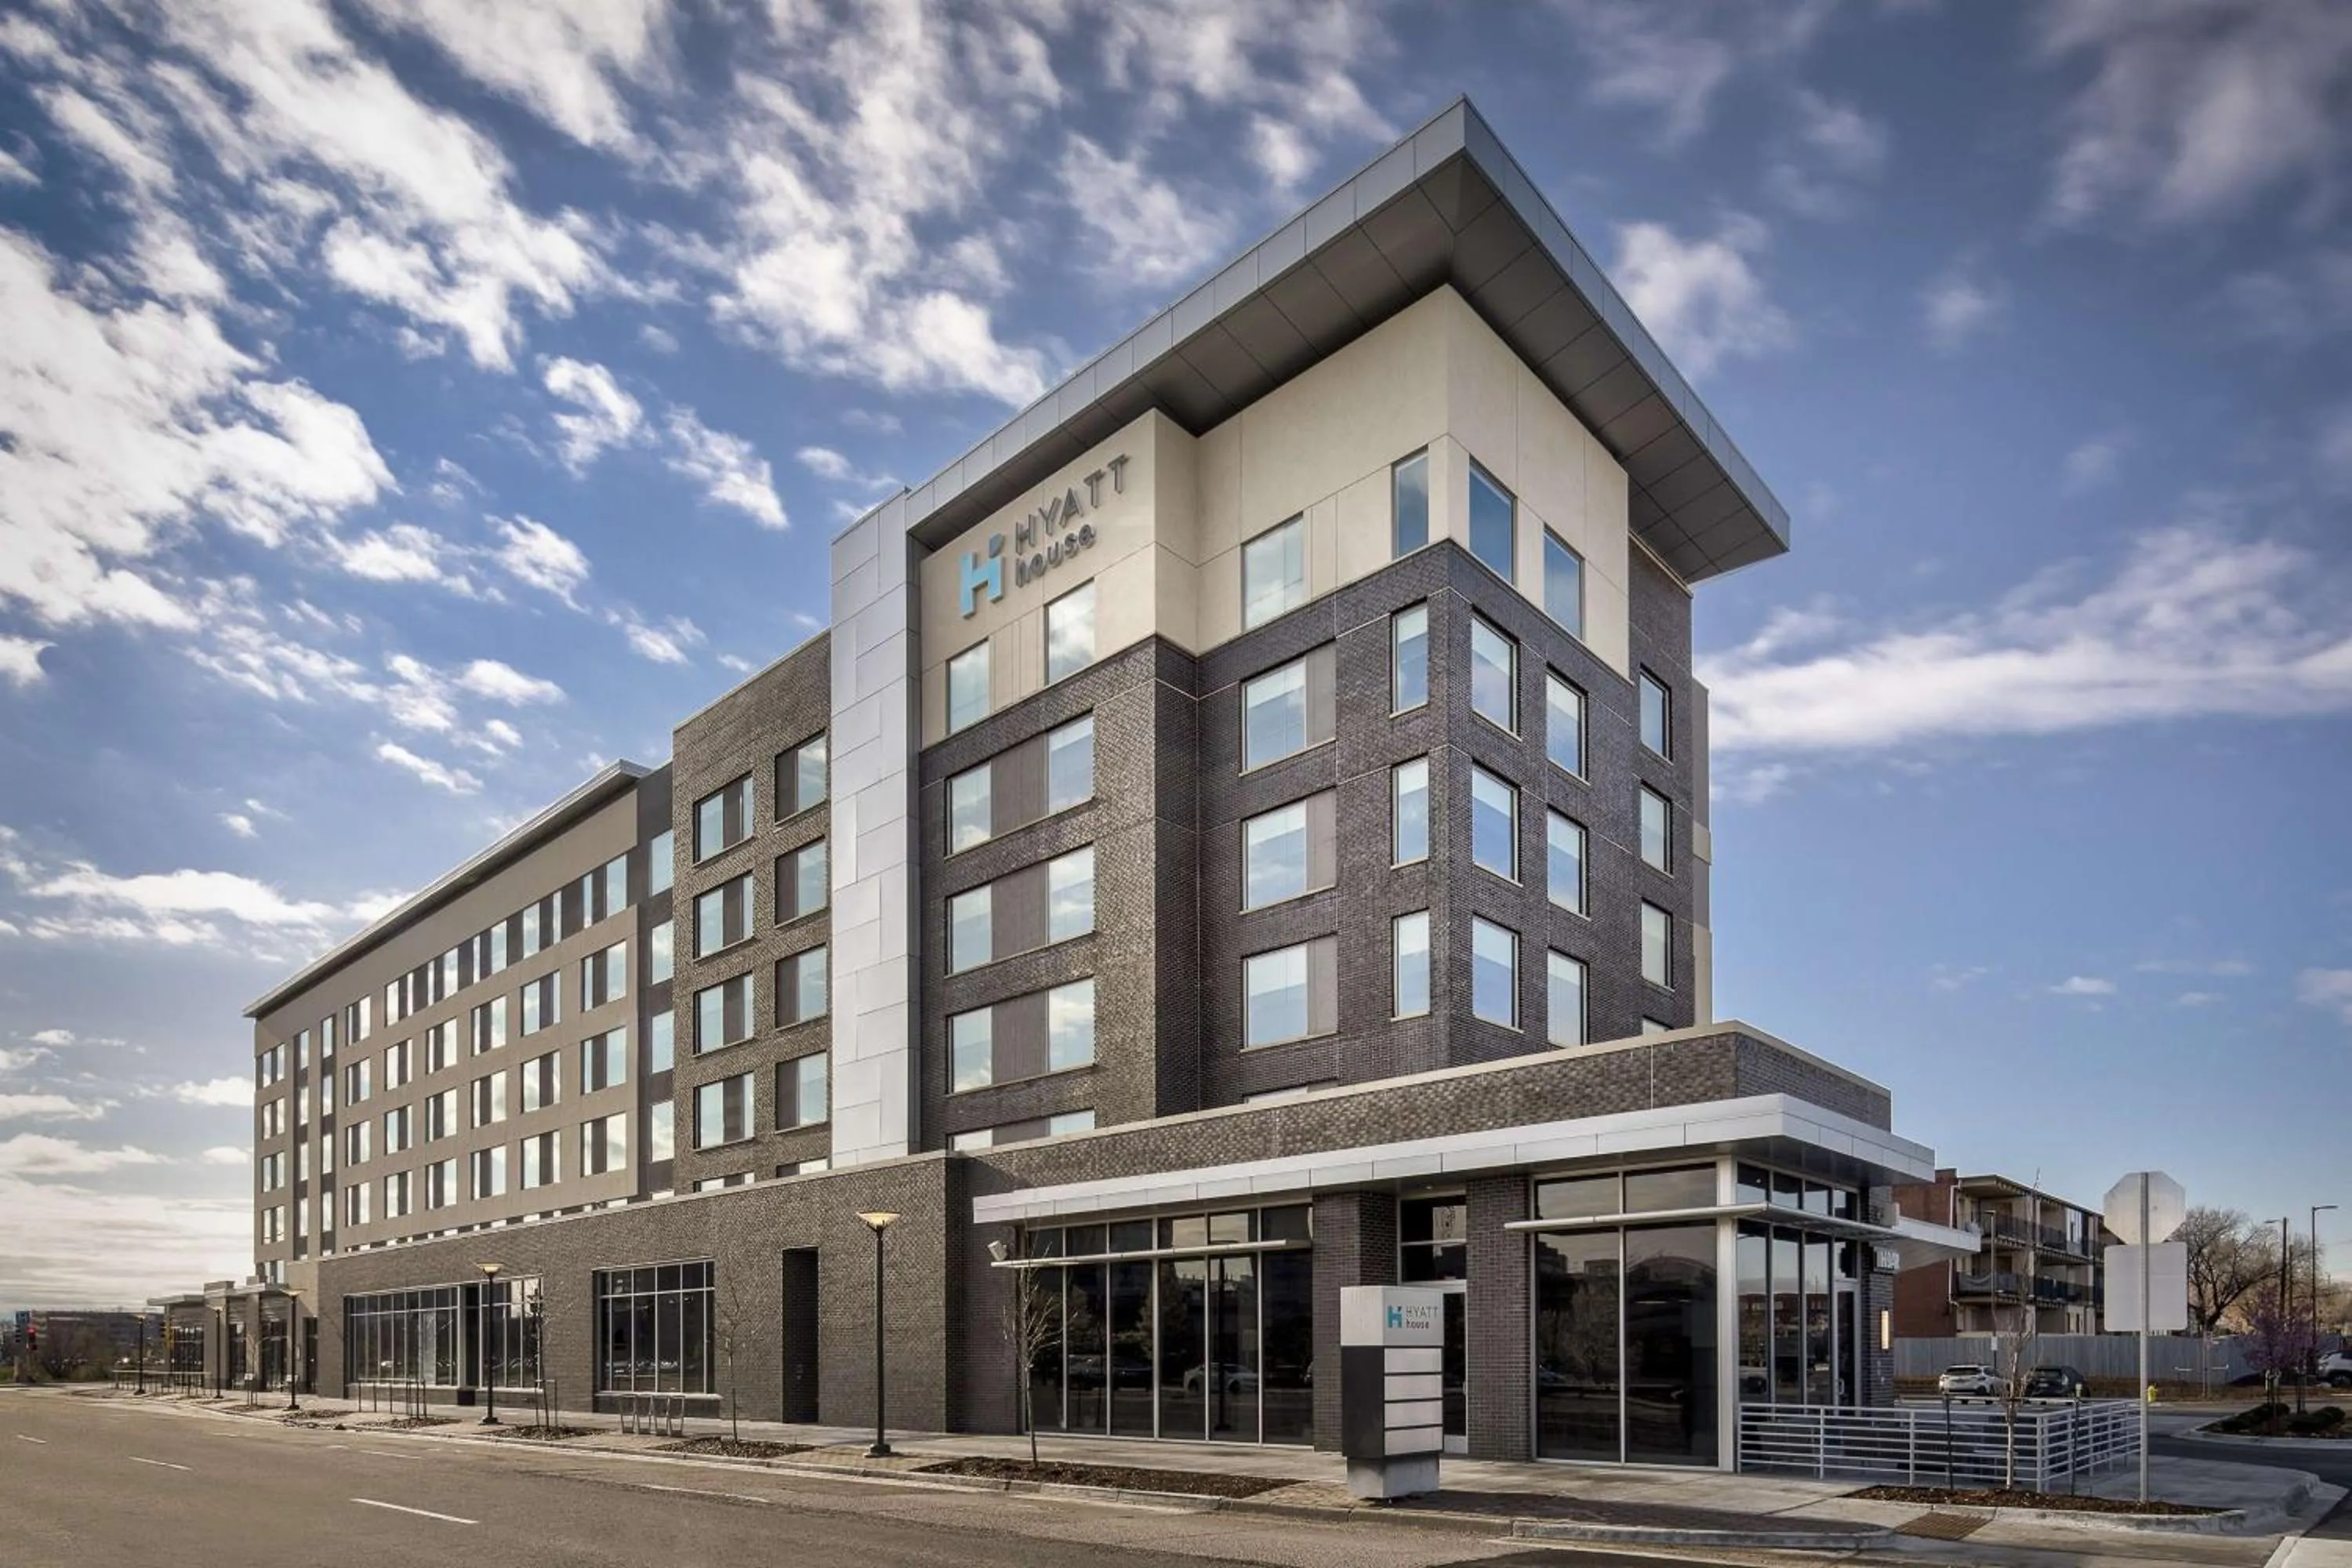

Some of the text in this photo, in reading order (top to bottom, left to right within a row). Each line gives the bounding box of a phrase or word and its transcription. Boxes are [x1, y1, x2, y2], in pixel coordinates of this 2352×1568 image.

[1015, 453, 1131, 556] HYATT
[1015, 524, 1096, 588] house
[1406, 1305, 1439, 1318] HYATT
[1406, 1319, 1429, 1329] house
